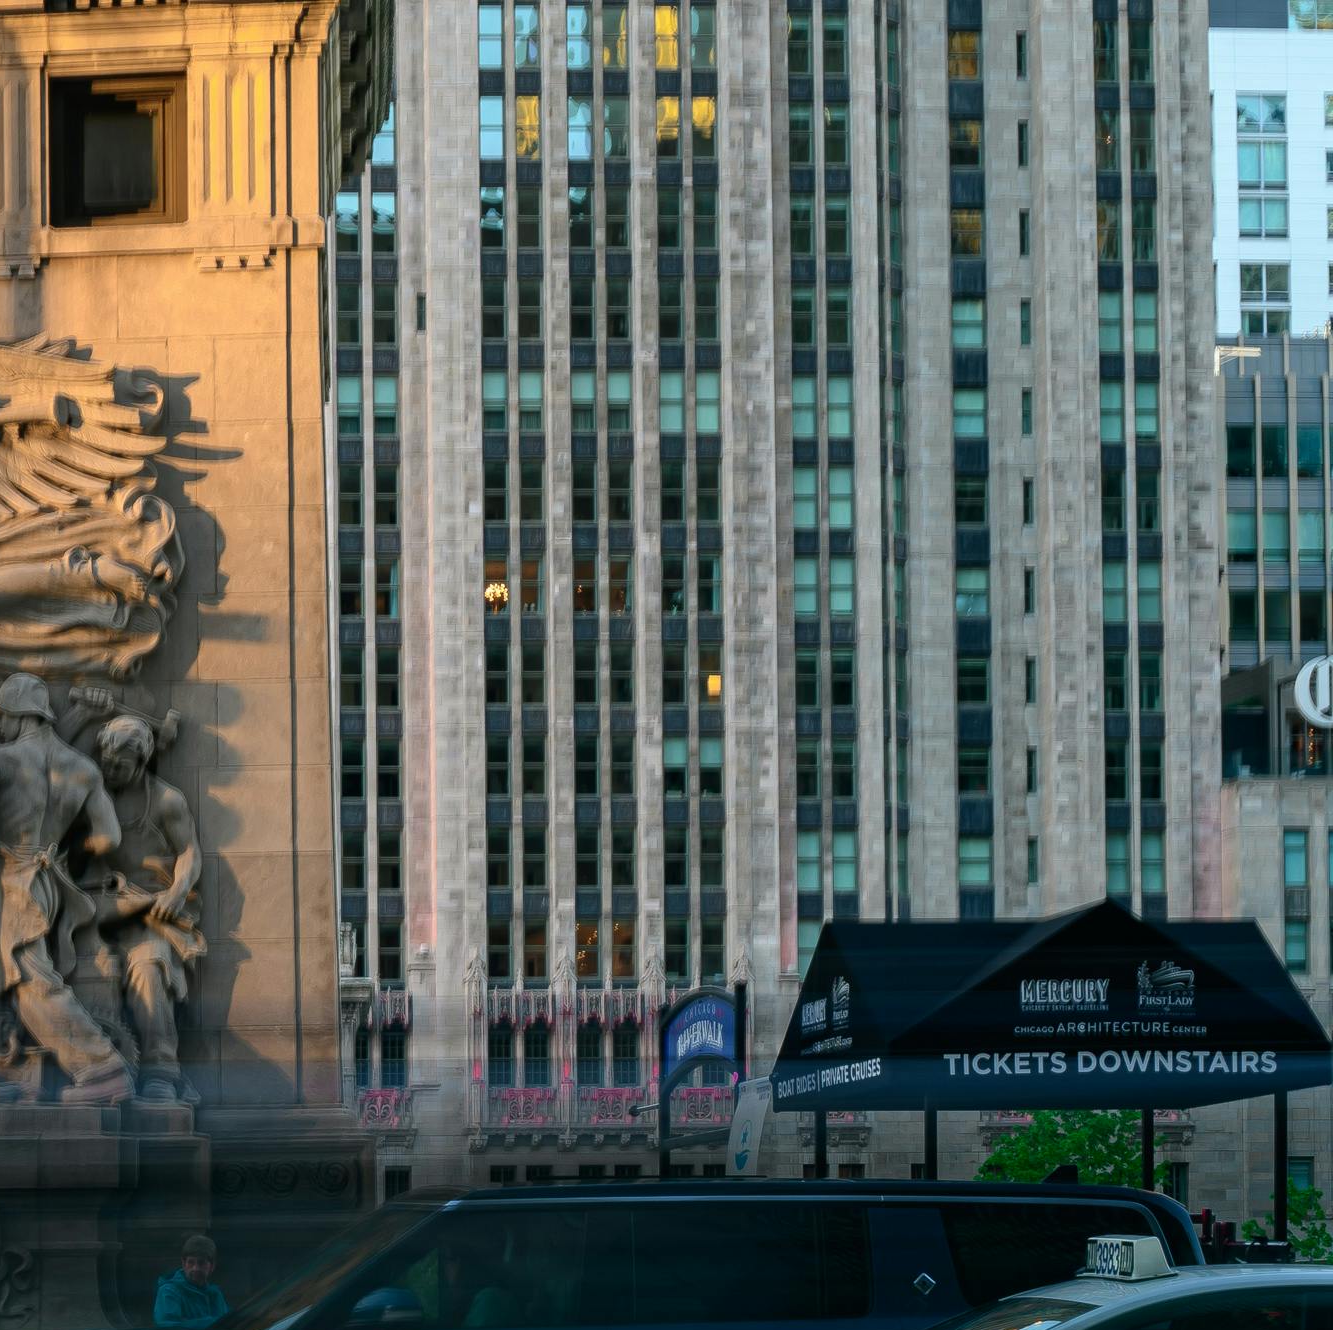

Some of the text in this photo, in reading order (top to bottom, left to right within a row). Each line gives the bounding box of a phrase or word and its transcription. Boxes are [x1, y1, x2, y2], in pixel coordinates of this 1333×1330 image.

[1020, 978, 1110, 1004] MERCURY
[684, 1003, 717, 1021] CHICAGO
[677, 1019, 724, 1057] RIVERWALK
[1014, 1021, 1208, 1034] CHICAGO ARCHITECTURE CENTER
[943, 1050, 1278, 1076] TICKETS DOWNSTAIRS
[778, 1079, 796, 1099] BOAT
[796, 1072, 816, 1094] RIDES
[821, 1064, 849, 1088] PRIVATE
[850, 1057, 881, 1082] CRUISES
[1096, 1242, 1120, 1275] 3983
